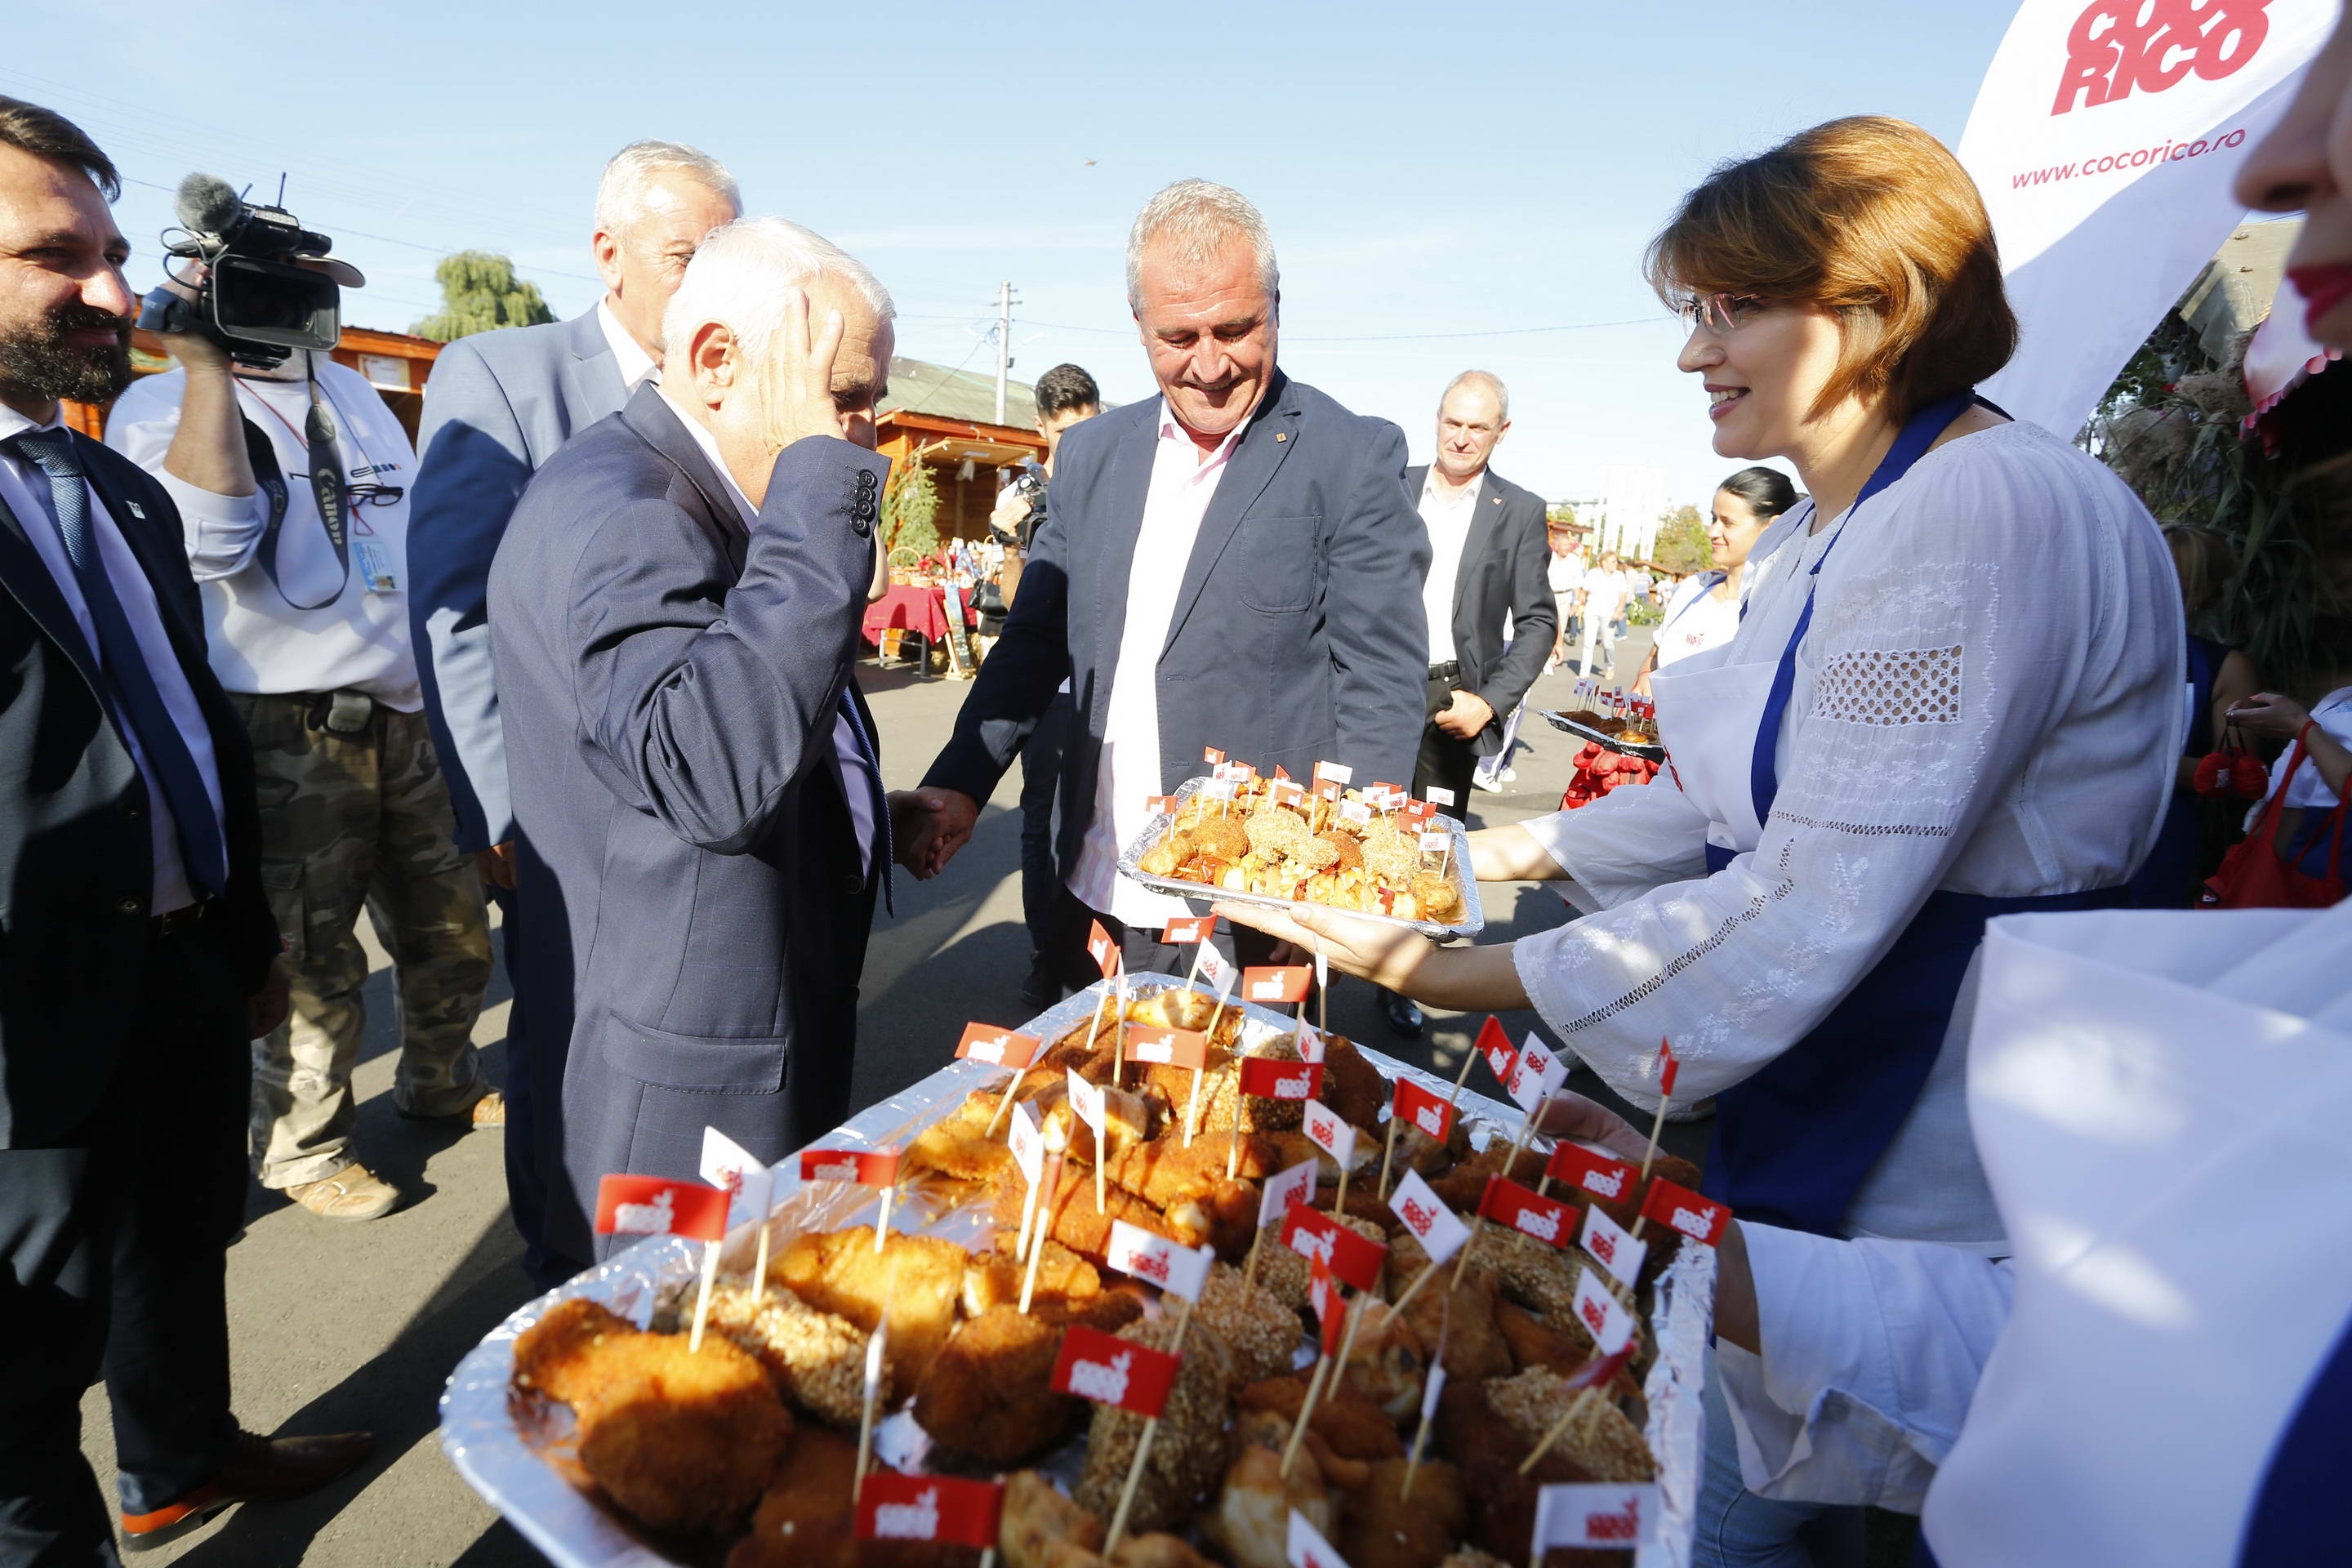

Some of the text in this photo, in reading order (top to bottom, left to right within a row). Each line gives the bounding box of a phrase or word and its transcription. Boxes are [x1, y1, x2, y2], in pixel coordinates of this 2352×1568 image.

[2050, 9, 2269, 116] RICO
[2012, 129, 2246, 189] www.cocorico.ro
[317, 468, 343, 545] Canon
